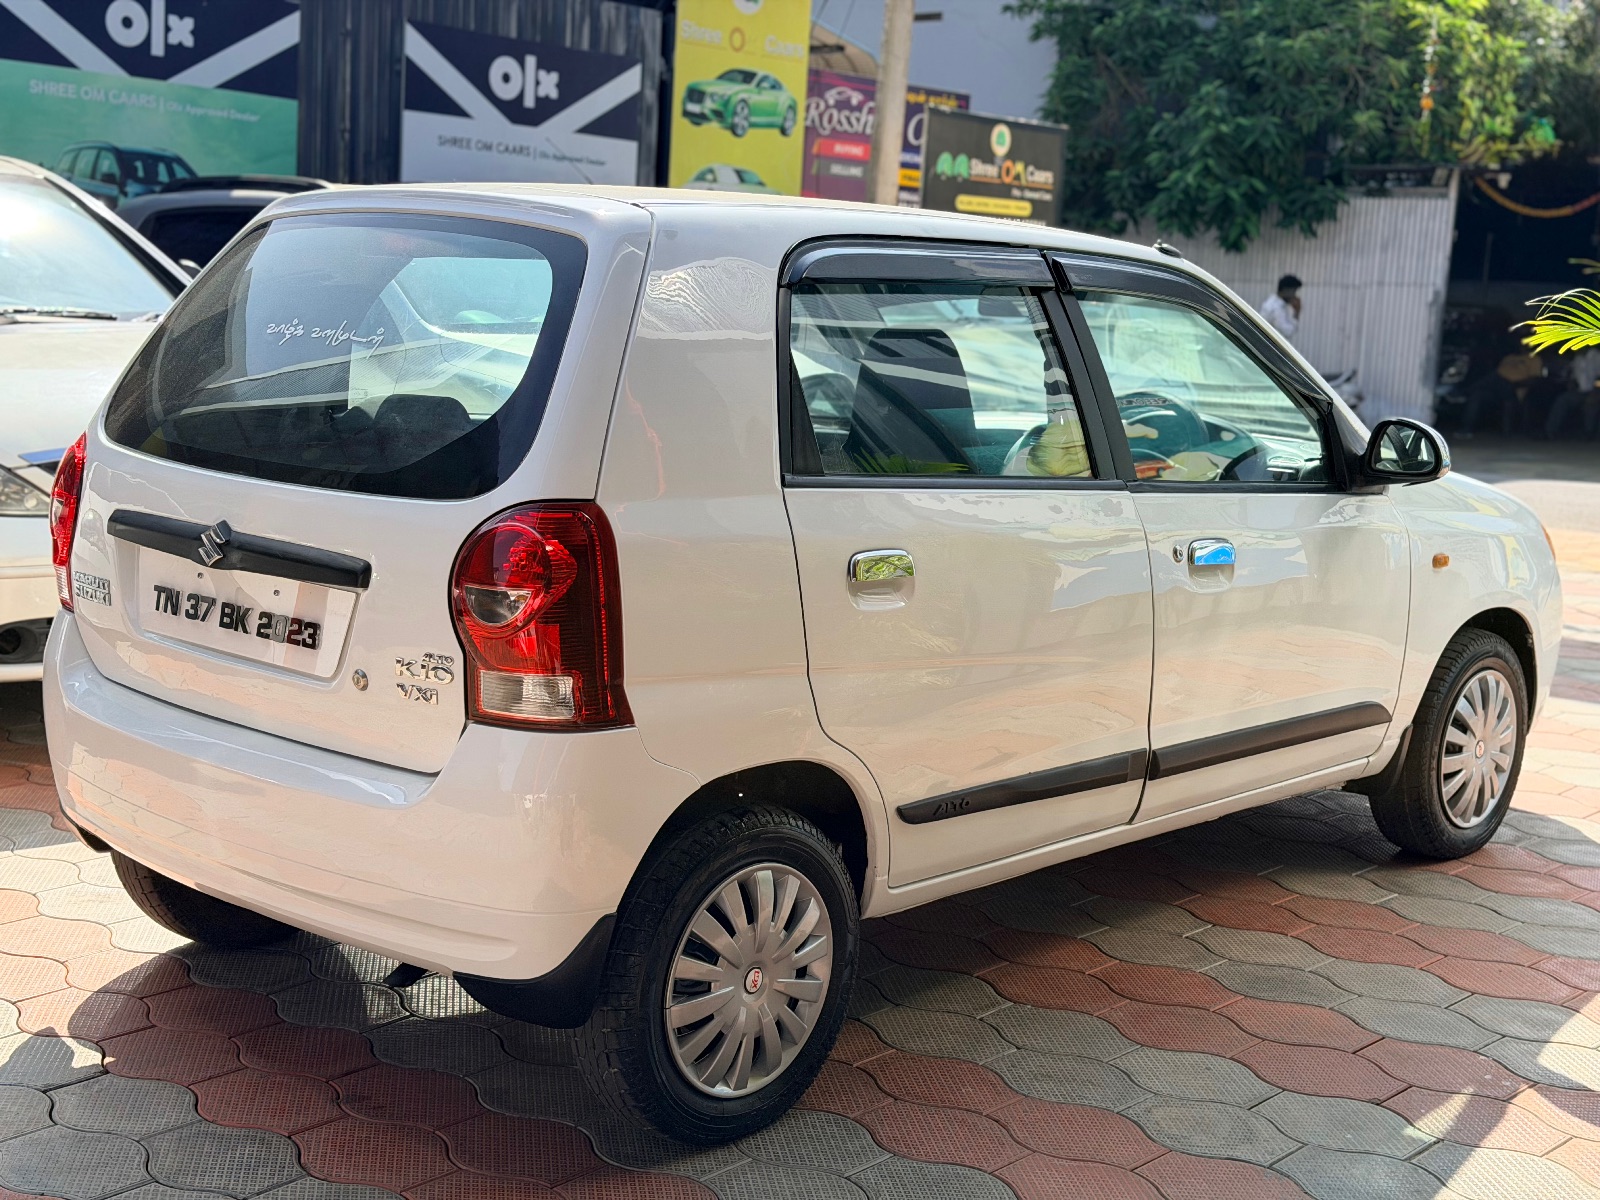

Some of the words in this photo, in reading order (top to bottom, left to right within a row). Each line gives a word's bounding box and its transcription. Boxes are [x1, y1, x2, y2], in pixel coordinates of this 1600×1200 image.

[29, 79, 77, 99] SHREE
[80, 85, 105, 102] OM
[108, 89, 156, 109] CAARS
[437, 134, 473, 151] SHREE
[475, 139, 494, 152] OM
[496, 141, 531, 157] CAARS
[73, 571, 110, 593] MARUTI
[75, 583, 111, 607] SUZUKI
[153, 585, 182, 616] TN
[184, 592, 217, 622] 37
[219, 601, 253, 635] BK
[256, 611, 321, 650] 2023
